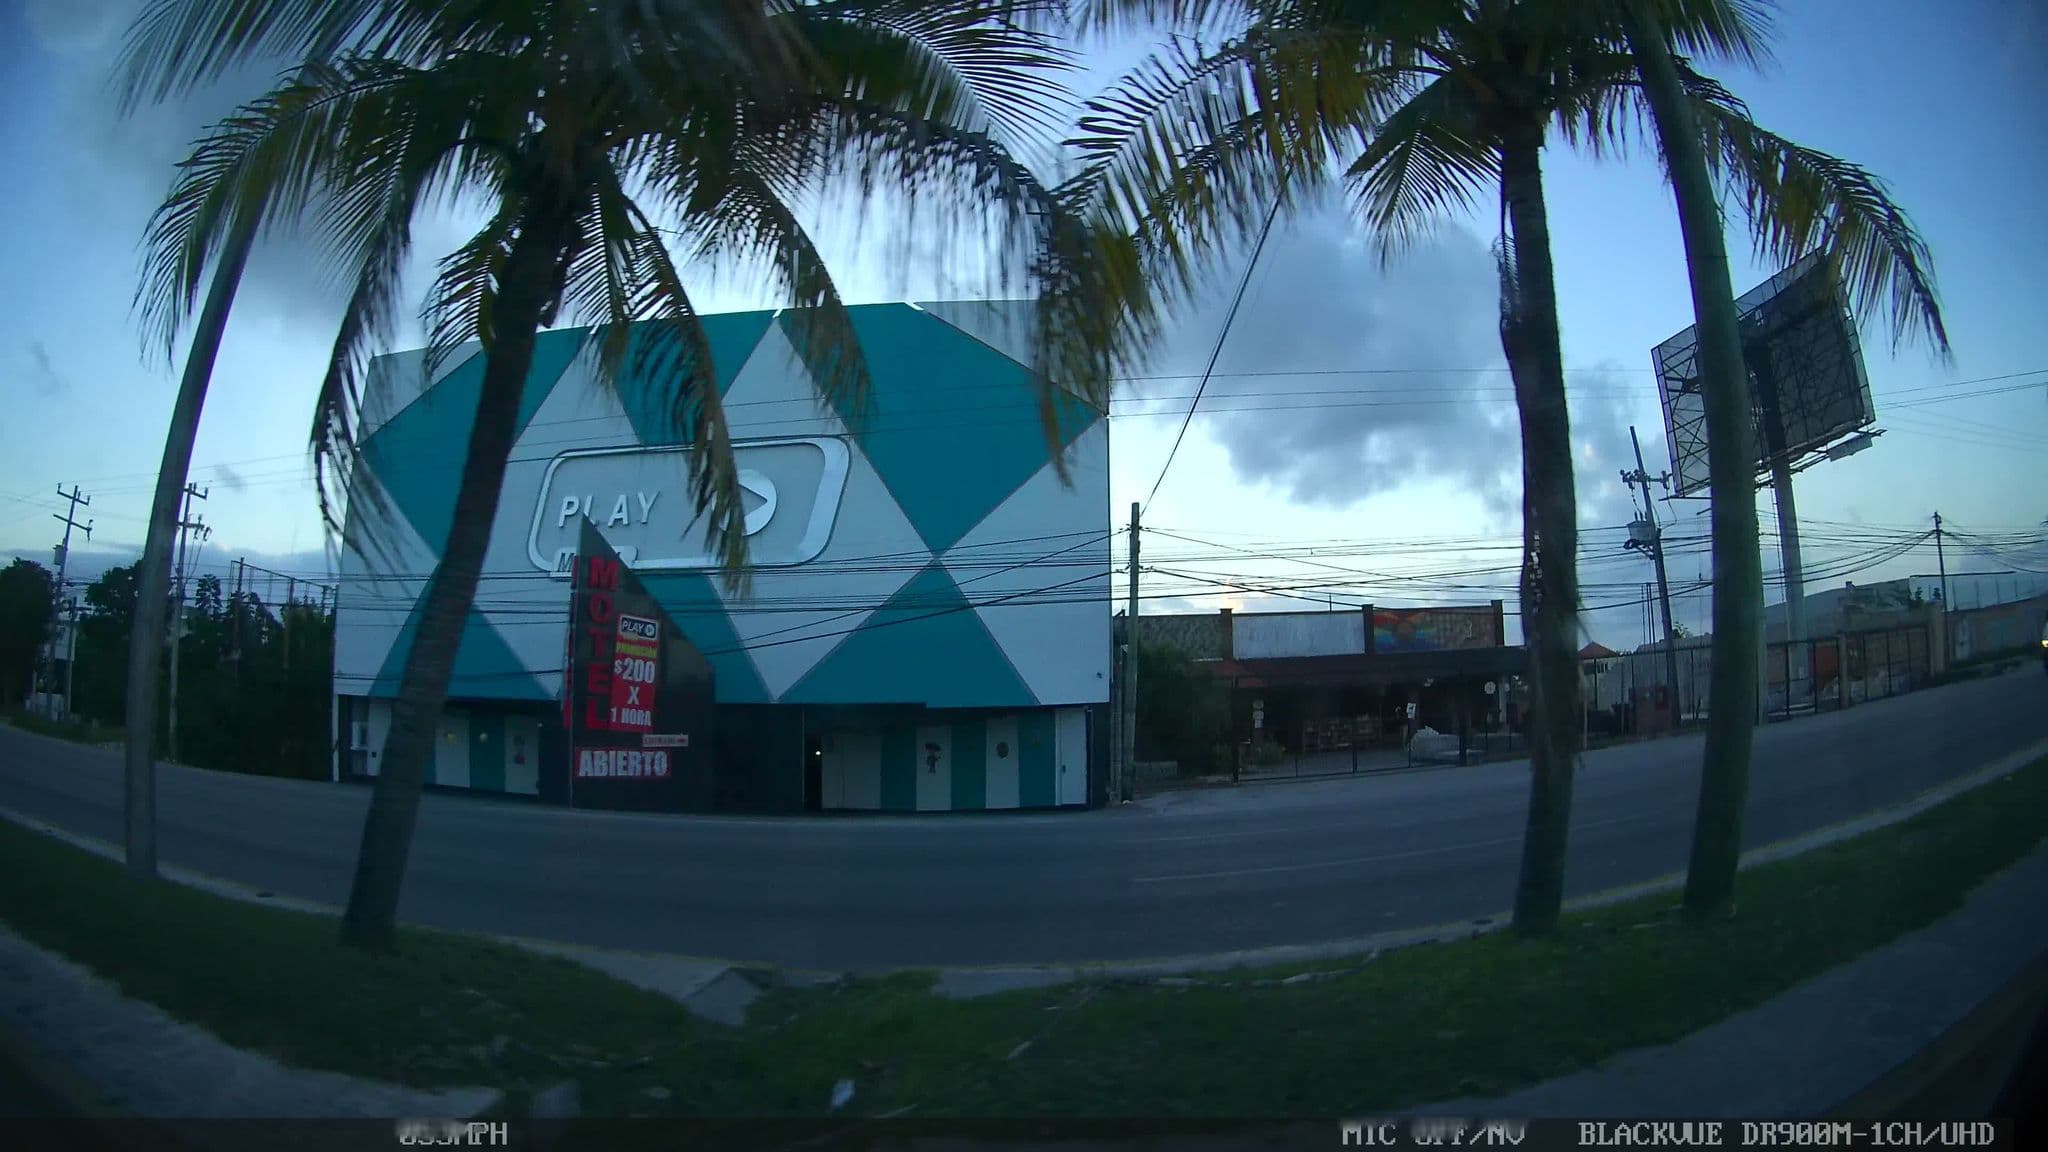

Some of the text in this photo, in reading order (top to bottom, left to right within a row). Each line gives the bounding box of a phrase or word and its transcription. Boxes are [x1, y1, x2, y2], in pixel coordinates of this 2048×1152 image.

[558, 489, 660, 528] PLAY
[622, 620, 644, 635] PLAY
[586, 555, 620, 729] MOTEL
[614, 657, 656, 684] $200
[627, 686, 640, 706] X
[610, 707, 652, 726] 1 HORA
[579, 750, 668, 777] ABIERTO
